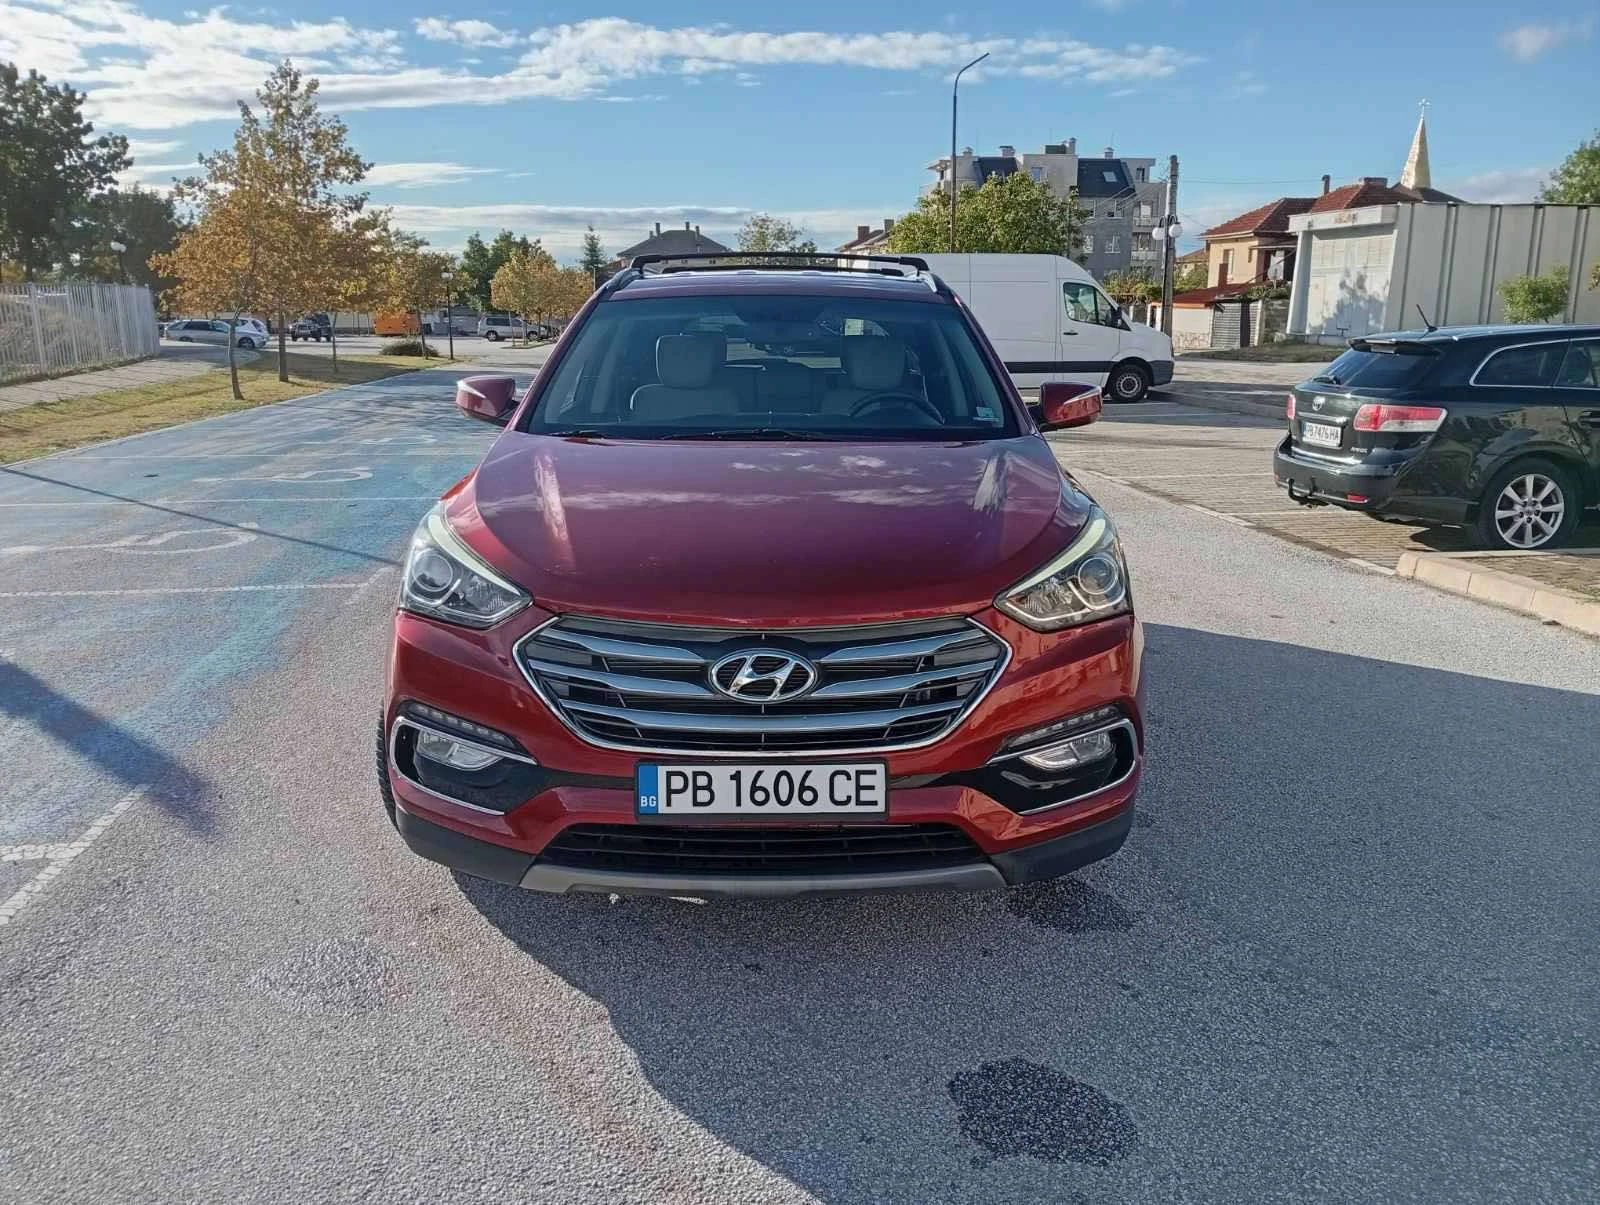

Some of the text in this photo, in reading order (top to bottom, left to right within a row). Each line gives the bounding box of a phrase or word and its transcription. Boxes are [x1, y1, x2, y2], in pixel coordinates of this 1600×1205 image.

[640, 795, 657, 808] BG
[665, 769, 879, 808] PB 1606 CE
